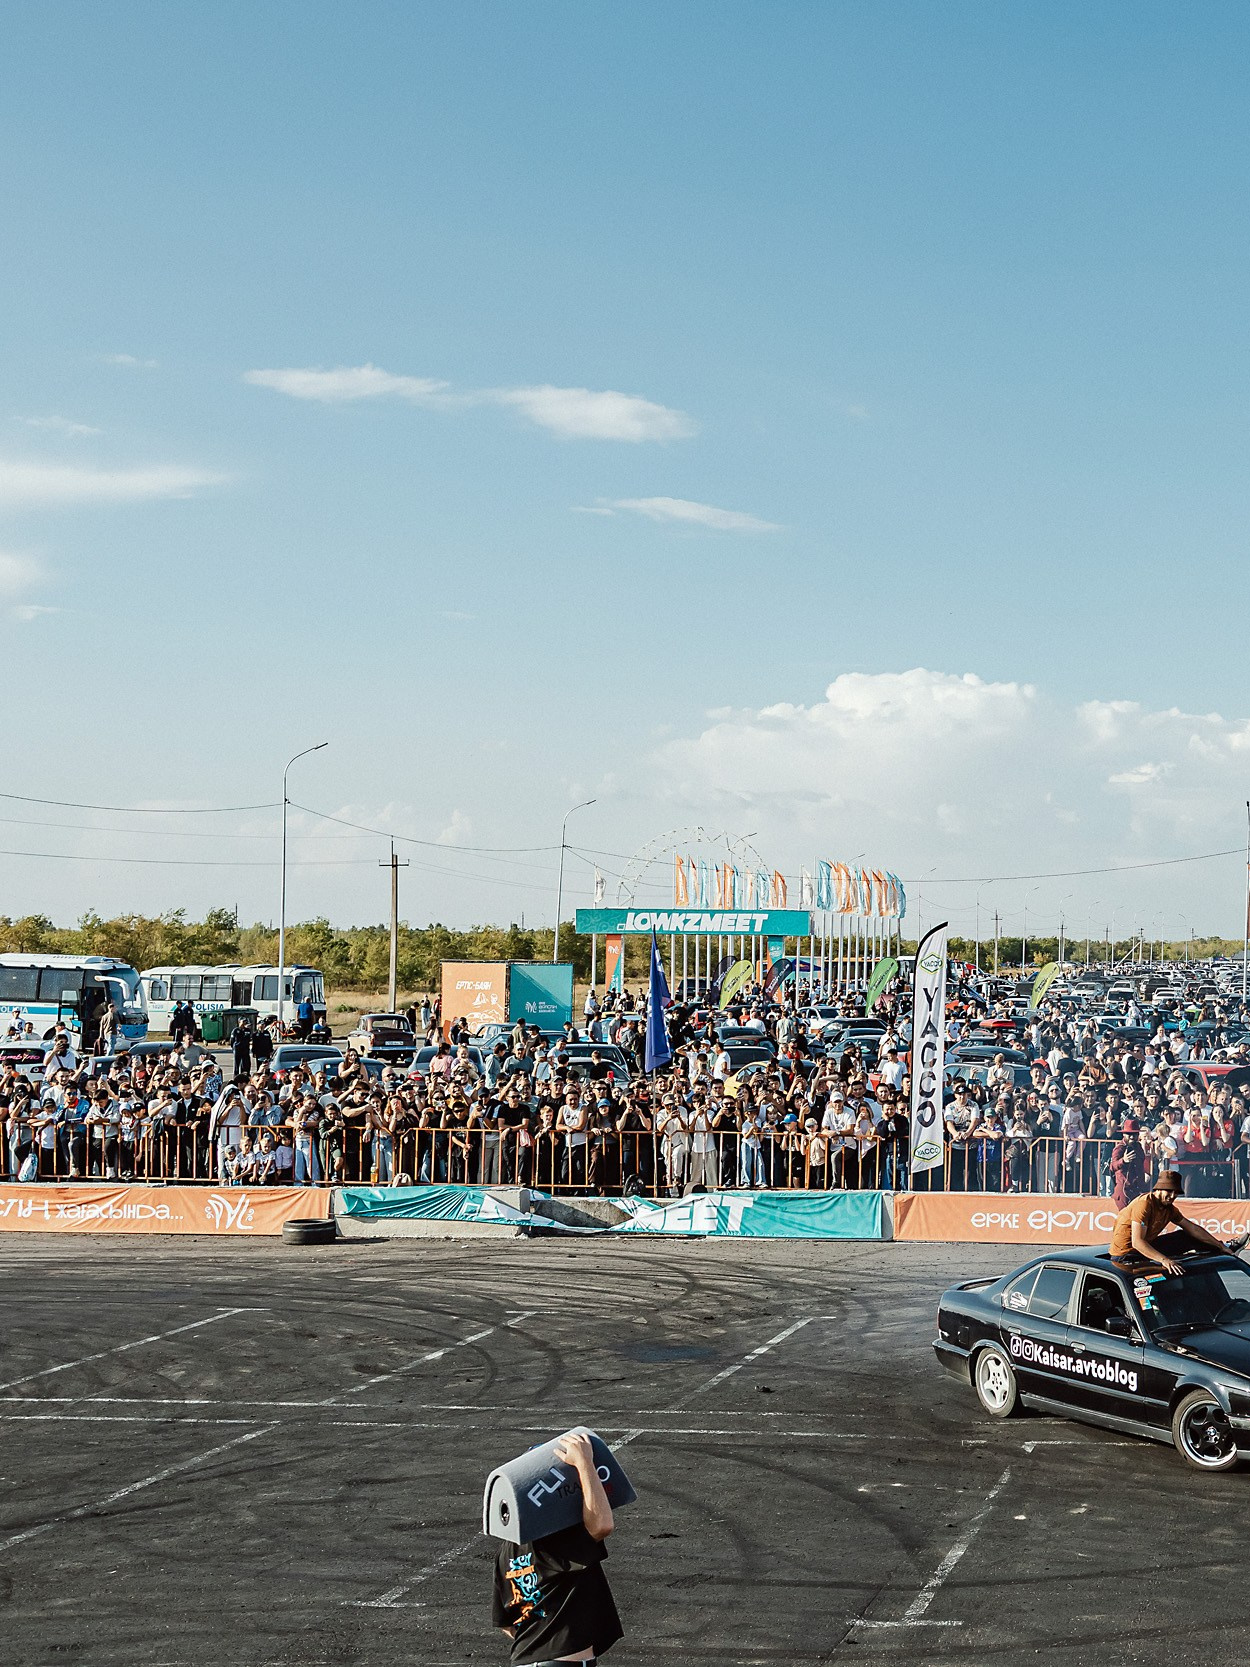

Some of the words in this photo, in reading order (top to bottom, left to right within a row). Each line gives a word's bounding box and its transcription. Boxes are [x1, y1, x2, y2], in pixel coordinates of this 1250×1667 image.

[924, 960, 942, 968] YACCO
[917, 987, 939, 1128] YACCO
[917, 1148, 939, 1156] YACCO
[1033, 1344, 1138, 1392] Kaisar.avtoblog
[527, 1467, 566, 1507] FLI
[557, 1482, 583, 1499] TRA
